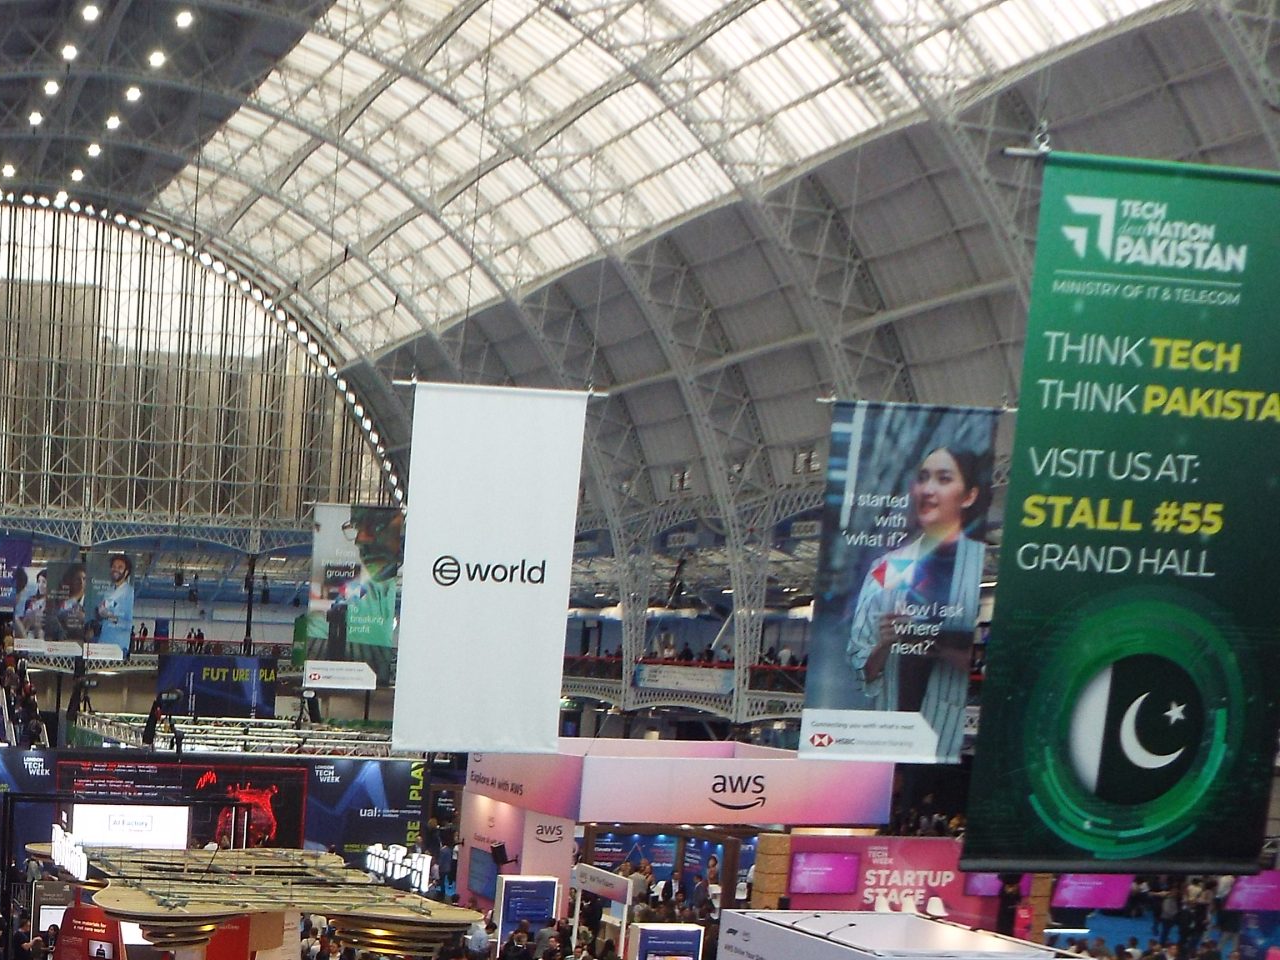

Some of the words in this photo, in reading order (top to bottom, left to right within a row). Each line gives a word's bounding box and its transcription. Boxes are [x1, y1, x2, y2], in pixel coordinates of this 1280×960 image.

[1121, 200, 1168, 220] TECH
[1114, 236, 1248, 273] PAKISTAN
[1052, 279, 1119, 295] MINISTRY
[1122, 285, 1144, 298] OF
[1147, 286, 1159, 299] IT
[1162, 287, 1172, 300] &
[1175, 288, 1241, 305] TELECOM
[1043, 330, 1145, 368] THINK
[1149, 336, 1242, 374] TECH
[1037, 378, 1139, 414] THINK
[1029, 446, 1104, 479] VISIT
[1107, 451, 1152, 482] US
[1153, 453, 1201, 485] AT:
[857, 493, 910, 508] started
[873, 514, 908, 528] with
[1021, 494, 1142, 532] STALL
[1151, 500, 1225, 536] #55
[1016, 542, 1131, 574] GRAND
[1137, 547, 1216, 578] HALL
[326, 568, 355, 578] ground
[466, 559, 546, 584] world
[895, 601, 929, 618] Now
[939, 604, 964, 618] ask
[202, 667, 229, 682] FUT
[232, 668, 250, 682] URE
[470, 770, 490, 787] Explore
[712, 774, 765, 794] aws
[360, 807, 381, 818] ual:
[536, 824, 563, 836] aws
[864, 869, 955, 888] STARTUP
[863, 888, 926, 905] STAGE
